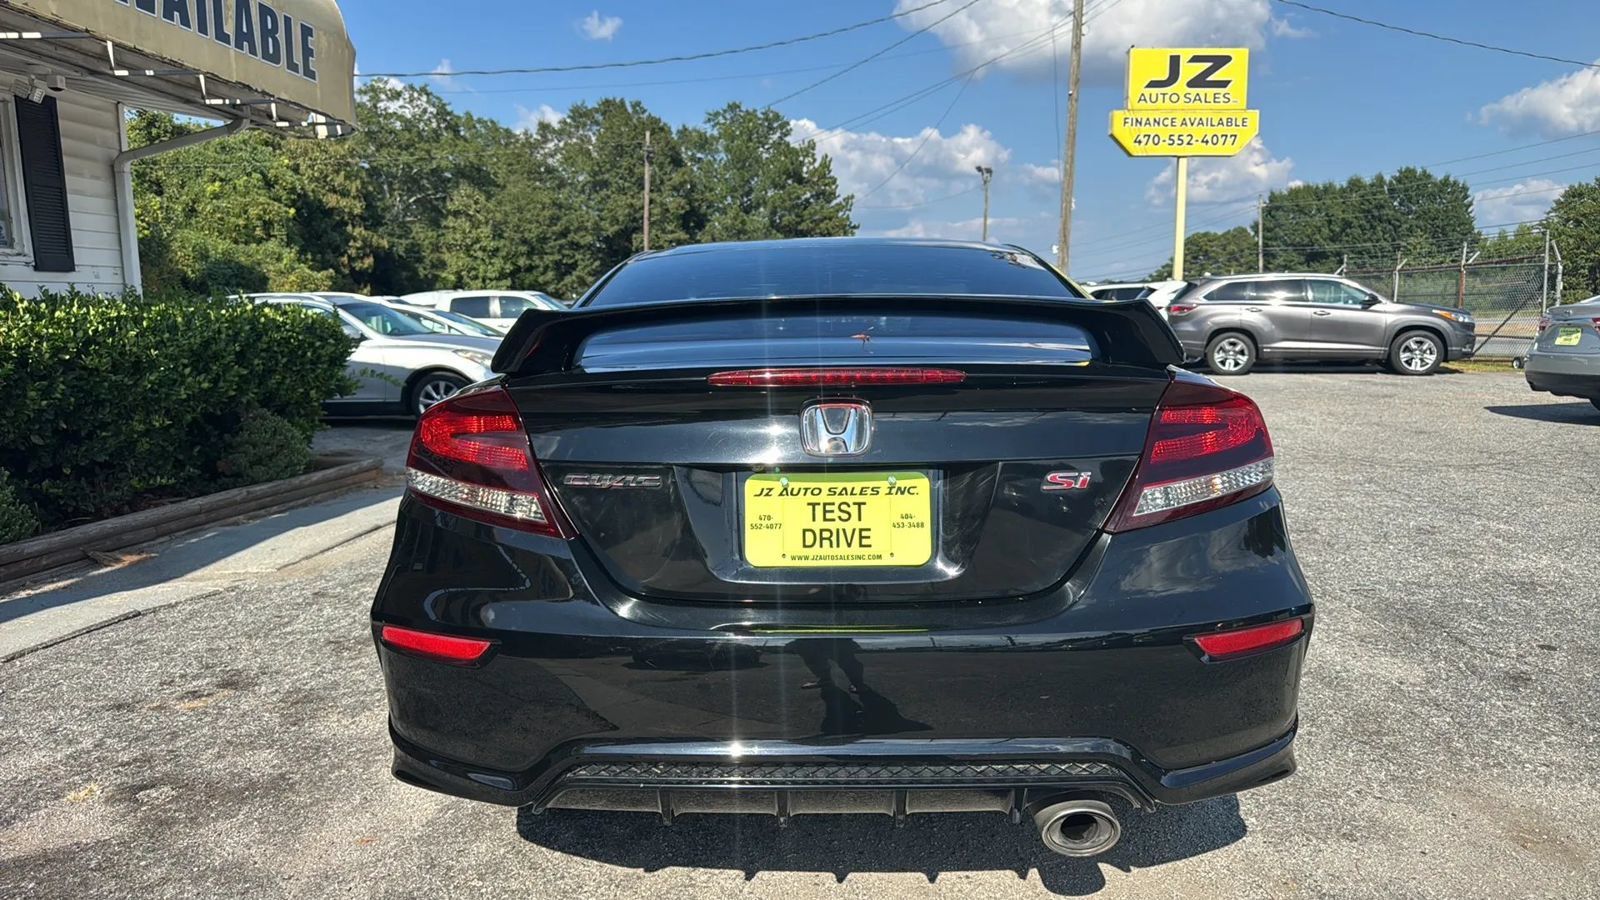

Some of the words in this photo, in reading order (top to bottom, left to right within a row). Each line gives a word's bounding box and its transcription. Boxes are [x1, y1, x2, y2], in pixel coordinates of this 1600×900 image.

[114, 0, 317, 82] ILABLE
[1144, 55, 1233, 88] JZ
[1137, 93, 1180, 104] AUTO
[1183, 93, 1231, 104] SALES
[1123, 117, 1177, 128] FINANCE
[1180, 117, 1249, 128] AVAILABLE
[1133, 134, 1238, 146] 470-552-4077
[753, 487, 775, 497] JZ
[778, 487, 822, 497] AUTO
[826, 486, 881, 496] SALES
[885, 485, 919, 496] INC.
[807, 501, 867, 522] TEST
[802, 528, 872, 548] DRIVE
